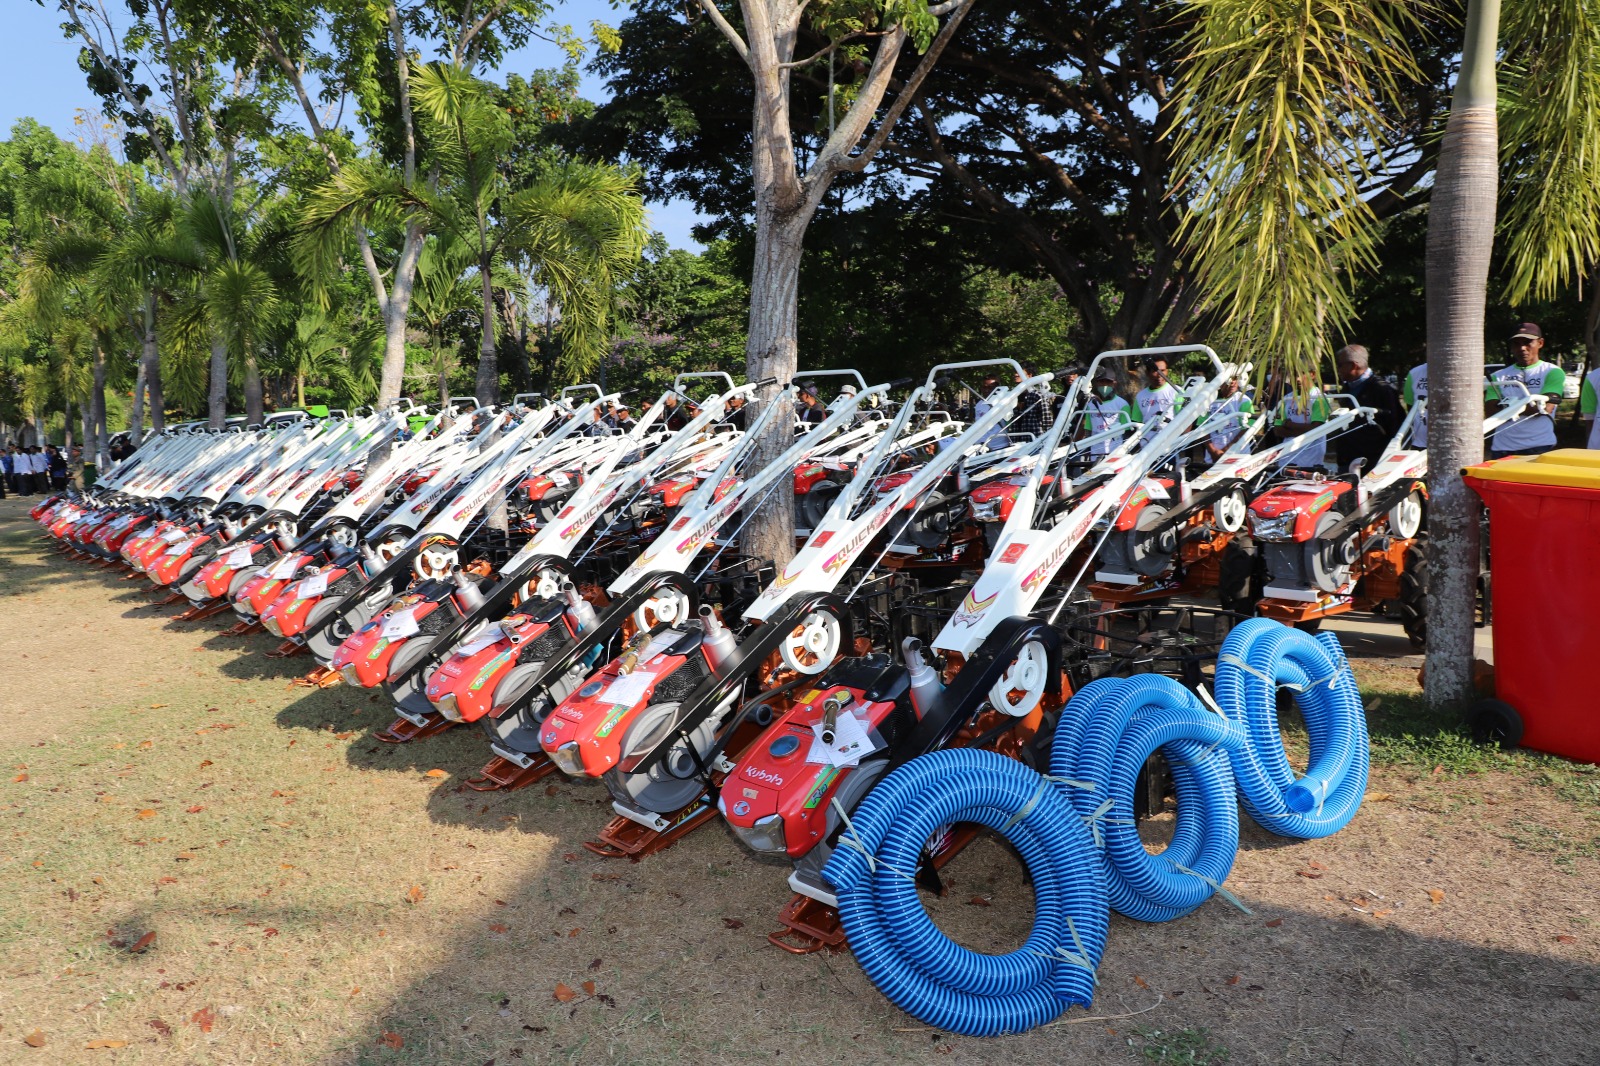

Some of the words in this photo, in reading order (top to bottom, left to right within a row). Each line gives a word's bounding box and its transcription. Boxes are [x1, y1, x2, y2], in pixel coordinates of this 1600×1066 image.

[361, 481, 386, 501] QUICK
[420, 486, 446, 507] QUICK
[463, 489, 490, 513] QUICK
[572, 502, 605, 532] QUICK
[690, 511, 726, 544] QUICK
[837, 523, 876, 561] QUICK
[1038, 531, 1076, 577] QUICK
[443, 662, 462, 675] Kubota
[560, 704, 584, 720] Kubota
[744, 765, 784, 786] Kubota
